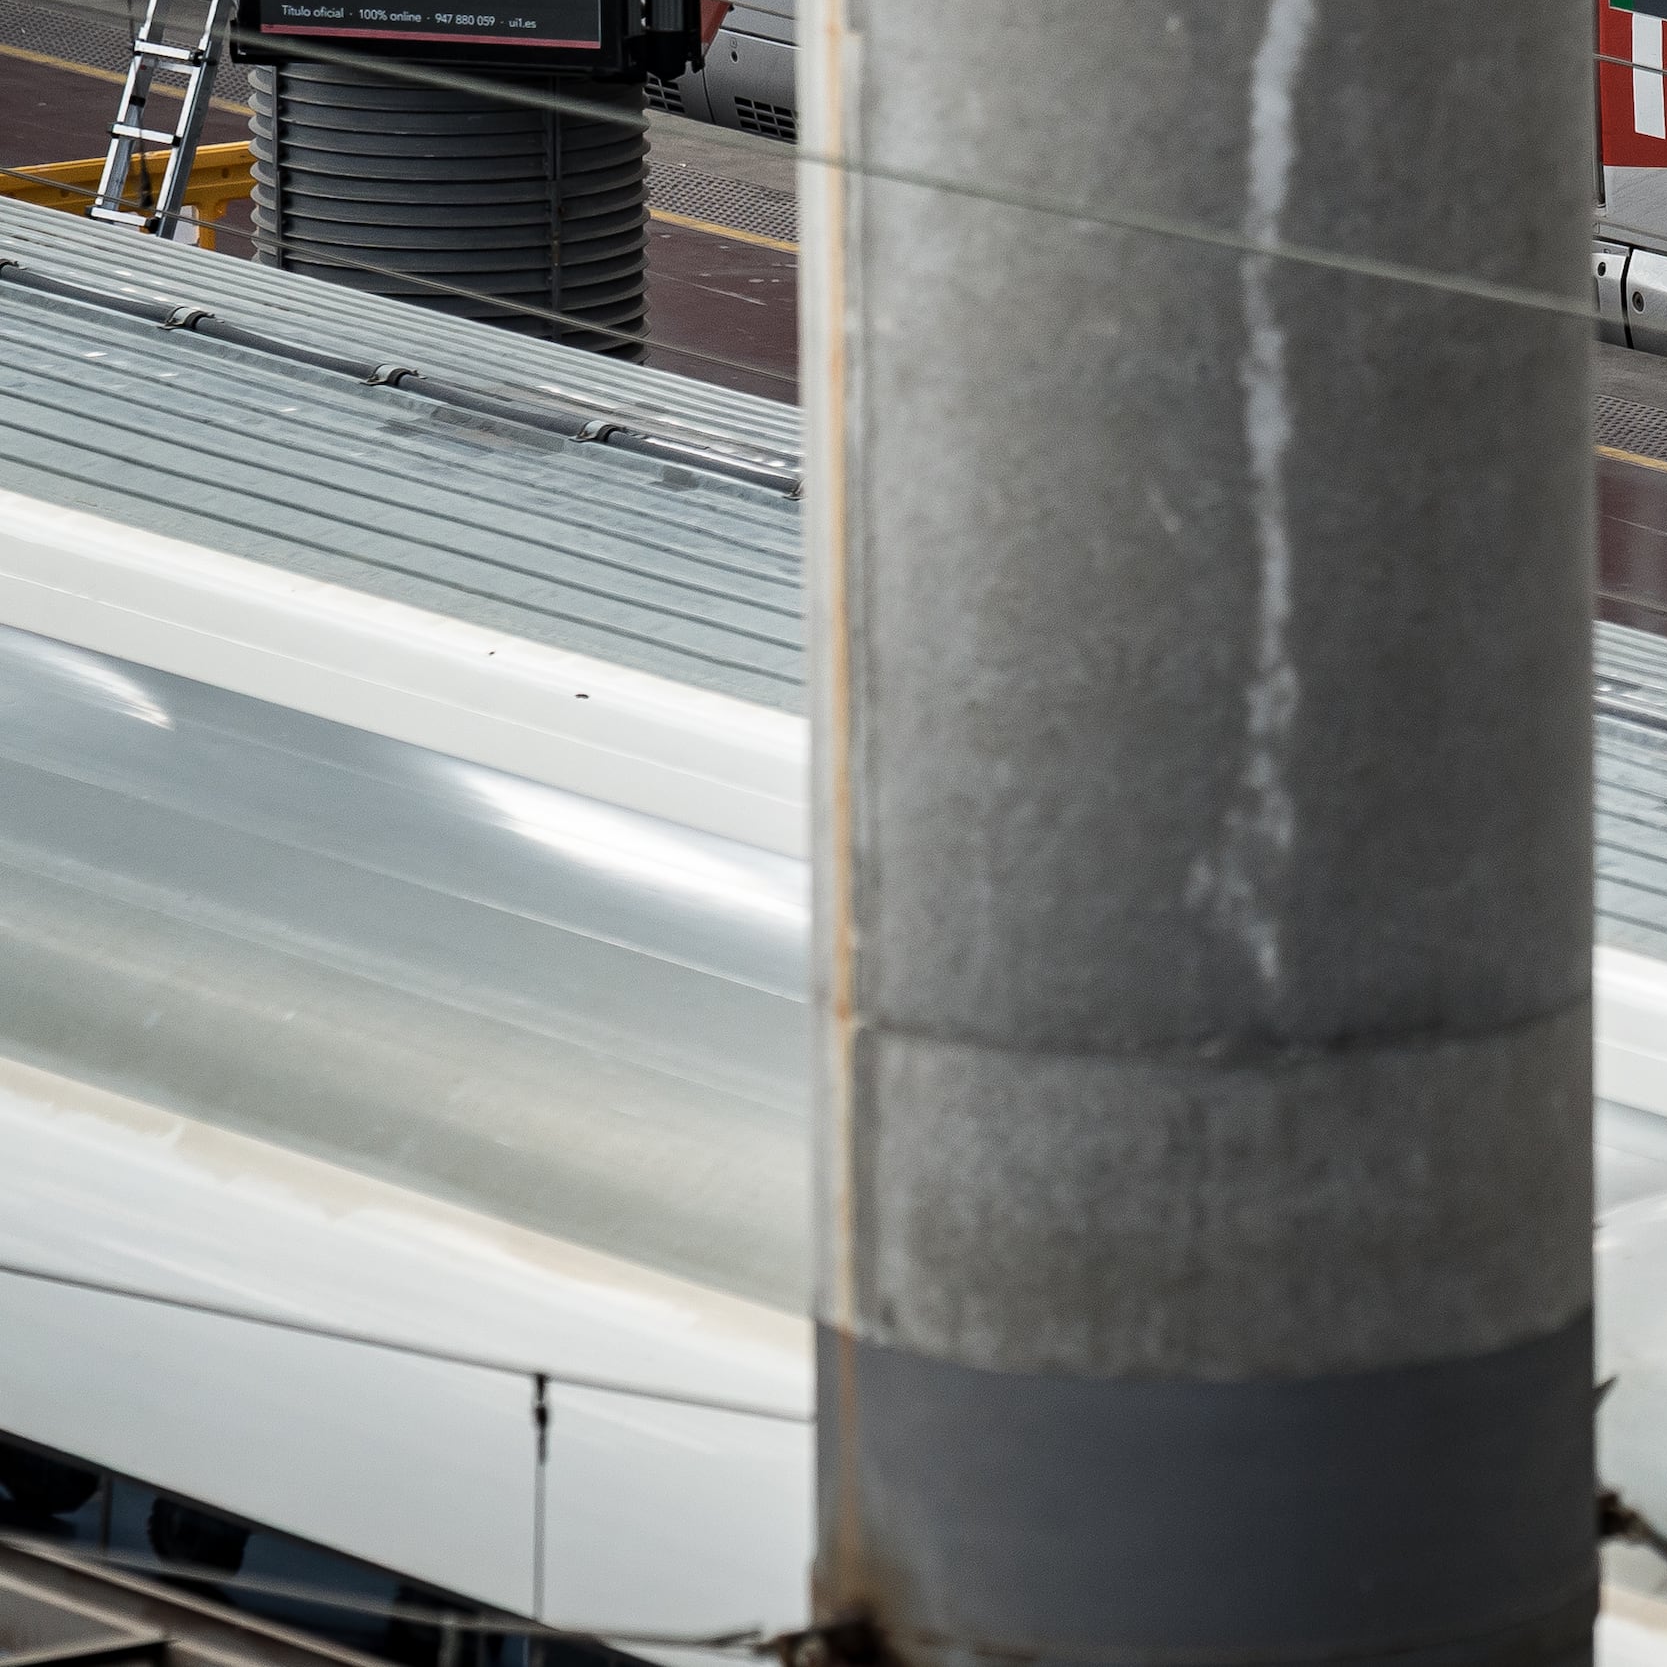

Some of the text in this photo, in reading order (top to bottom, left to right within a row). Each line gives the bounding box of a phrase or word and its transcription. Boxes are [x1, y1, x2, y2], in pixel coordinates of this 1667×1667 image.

[282, 4, 311, 17] Título
[312, 6, 344, 19] oficial
[359, 9, 388, 21] 100%
[390, 11, 422, 23] online
[434, 12, 453, 24] 947
[455, 14, 475, 26] 880
[476, 15, 496, 27] 059
